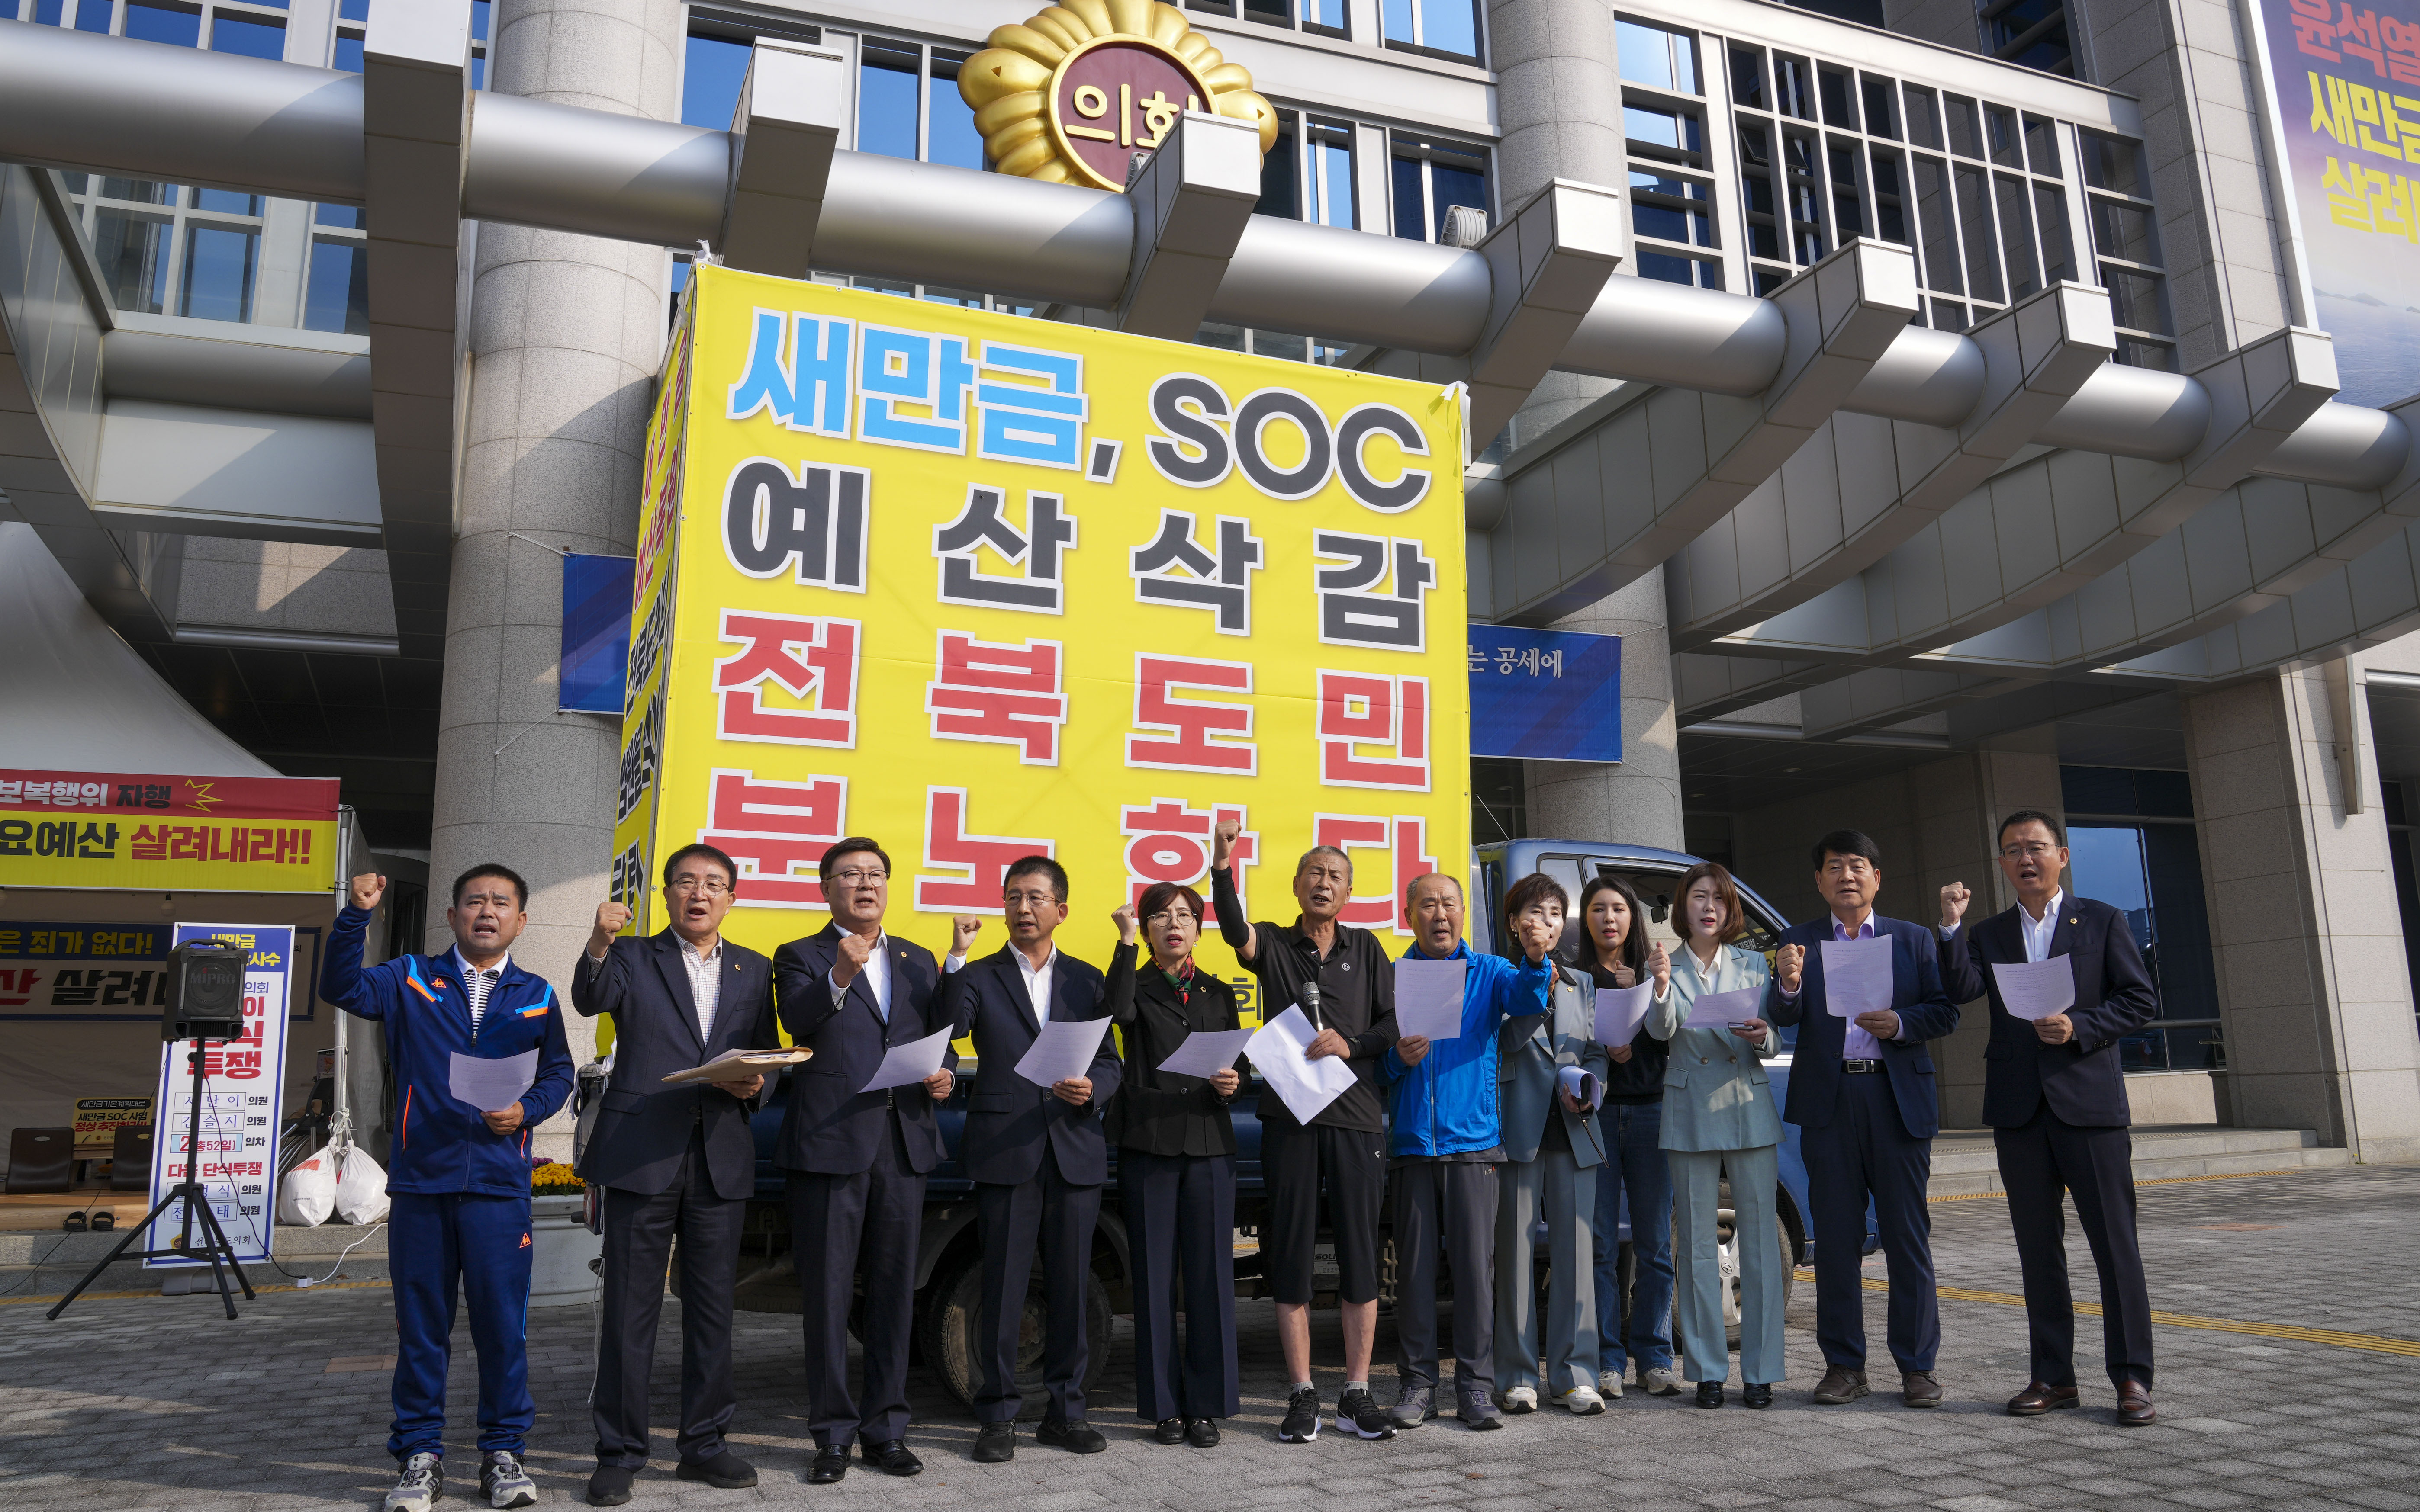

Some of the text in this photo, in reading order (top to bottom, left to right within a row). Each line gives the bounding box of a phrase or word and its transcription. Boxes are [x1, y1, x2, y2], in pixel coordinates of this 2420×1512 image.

[2321, 155, 2420, 244] 살려
[1146, 372, 1432, 514] SOC
[1493, 647, 1562, 678] 공세에
[0, 780, 171, 809] 보복행위 자행
[0, 820, 311, 864] 요예산 살려내라!!
[29, 931, 84, 954] 죄가
[91, 931, 153, 955] 없다!
[246, 952, 280, 966] 사수
[187, 1050, 262, 1079] 투쟁
[248, 1096, 268, 1106] 의원
[77, 1112, 148, 1121] 새만금 SOC 사업
[247, 1116, 267, 1126] 의원
[75, 1121, 97, 1132] 정상
[245, 1137, 265, 1147] 일차
[203, 1162, 262, 1177] 단식투쟁
[241, 1185, 261, 1194] 의원
[240, 1205, 260, 1215] 의원
[195, 1235, 250, 1246] 전도의회
